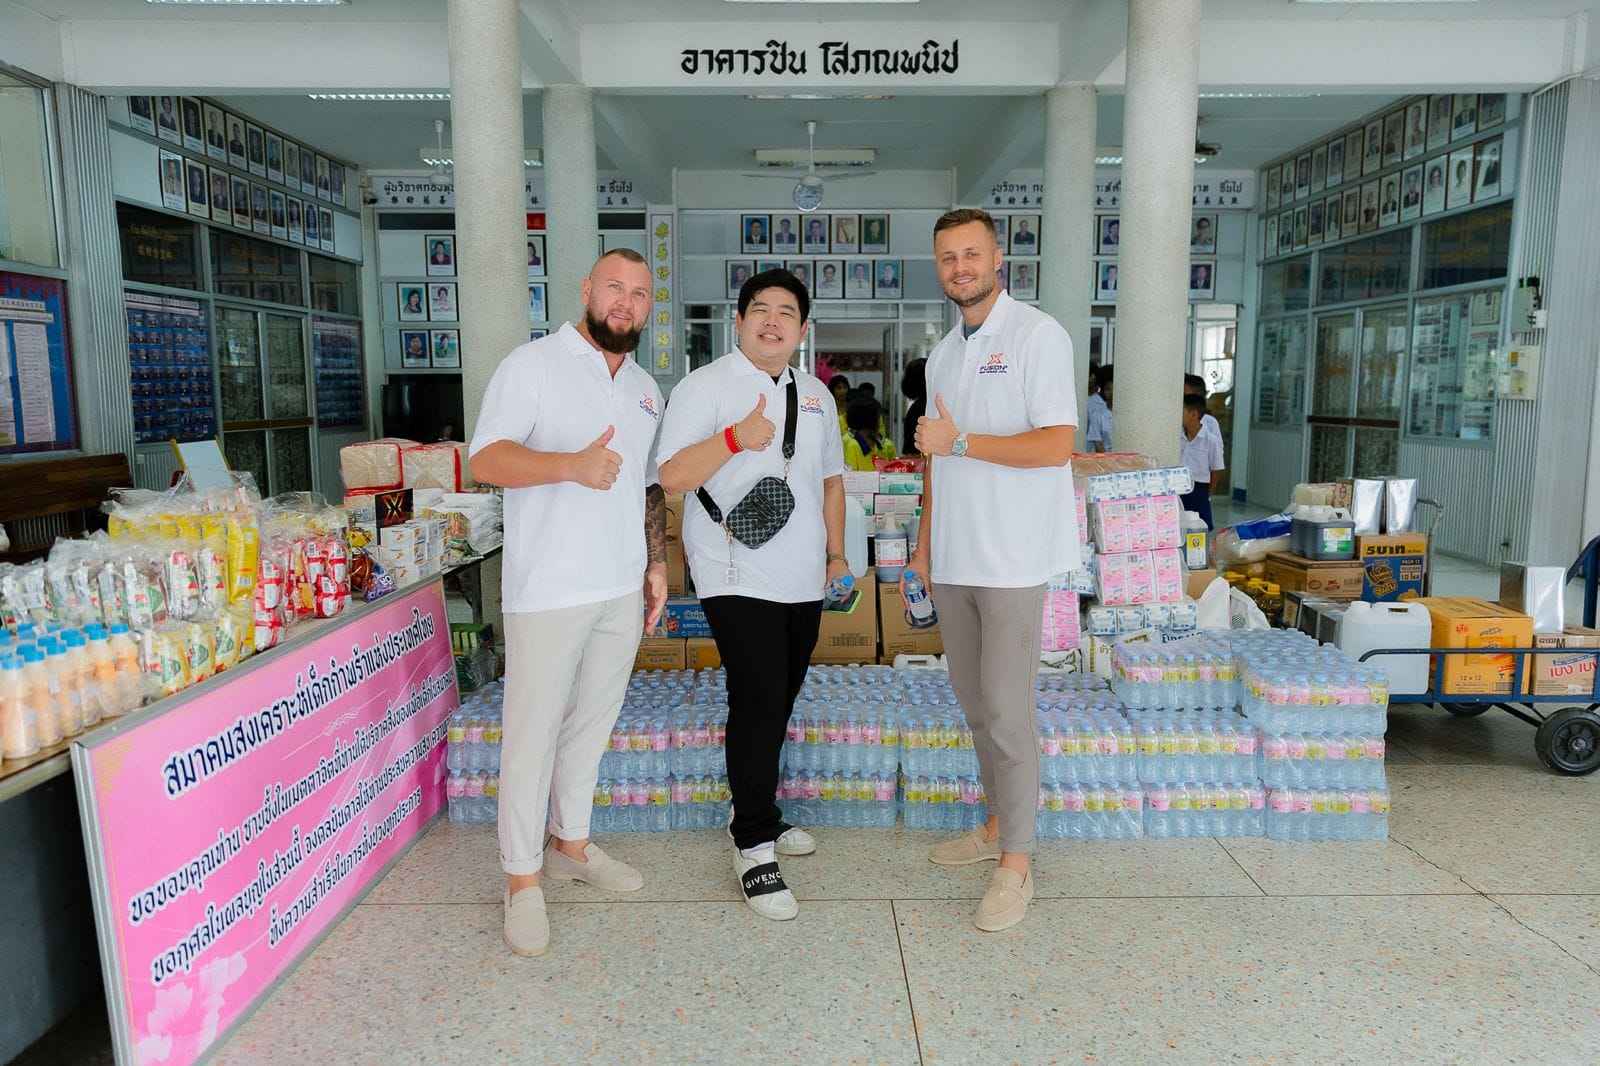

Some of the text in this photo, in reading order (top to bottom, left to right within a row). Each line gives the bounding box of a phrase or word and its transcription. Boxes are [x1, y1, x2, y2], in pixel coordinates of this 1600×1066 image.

[164, 607, 435, 795] สมาคมสงเคราะห์เด็กกำพร้าแห่งประเทศไทย
